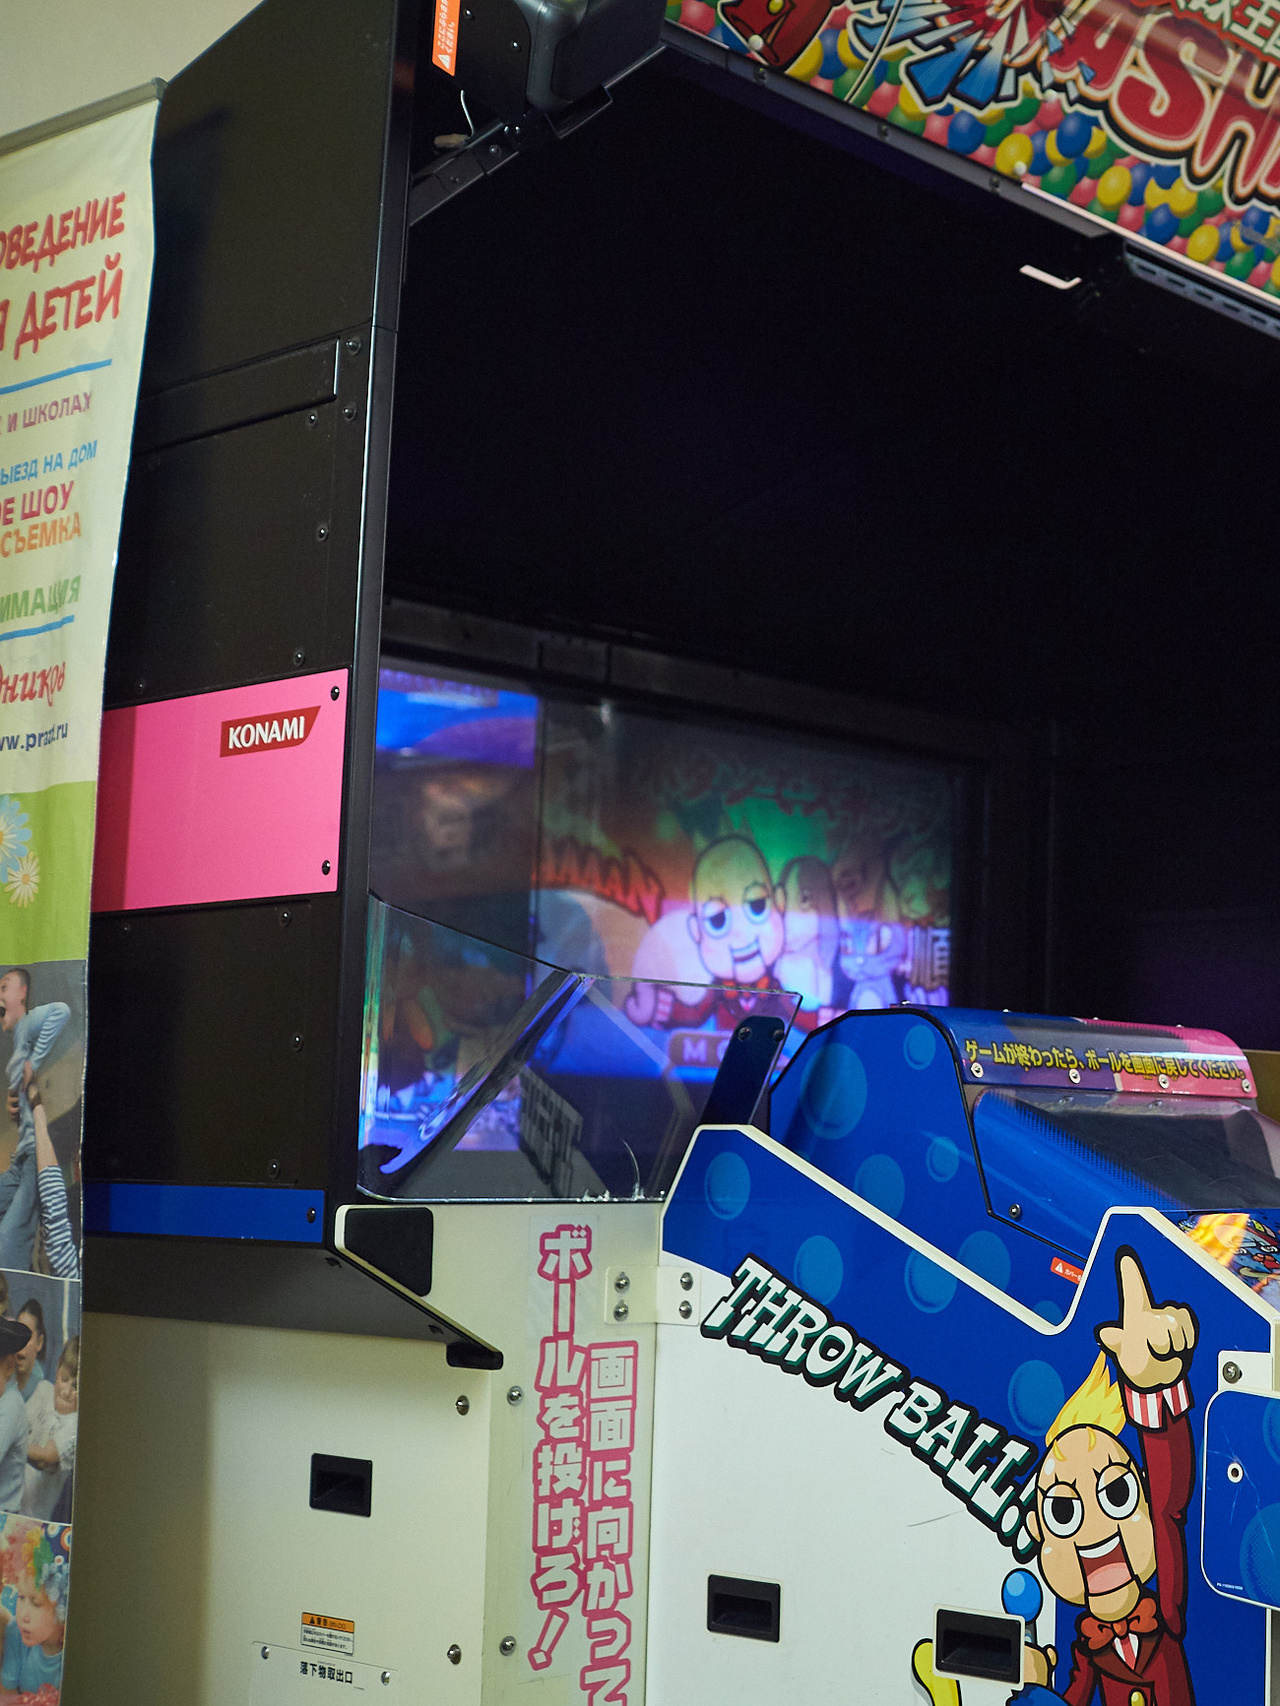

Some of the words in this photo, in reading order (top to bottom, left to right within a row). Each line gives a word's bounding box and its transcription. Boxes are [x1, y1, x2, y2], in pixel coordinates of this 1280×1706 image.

[13, 252, 123, 361] ДЕТЕЙ
[7, 412, 18, 433] И
[22, 390, 93, 429] ШКОЛАХ
[43, 452, 63, 474] НА
[68, 439, 98, 471] ДОМ
[20, 480, 74, 521] ШОУ
[228, 715, 306, 750] KONAMI
[701, 1253, 910, 1411] THROW
[579, 1341, 639, 1706] 画面に向かって
[299, 1660, 353, 1684] 落下物取出口
